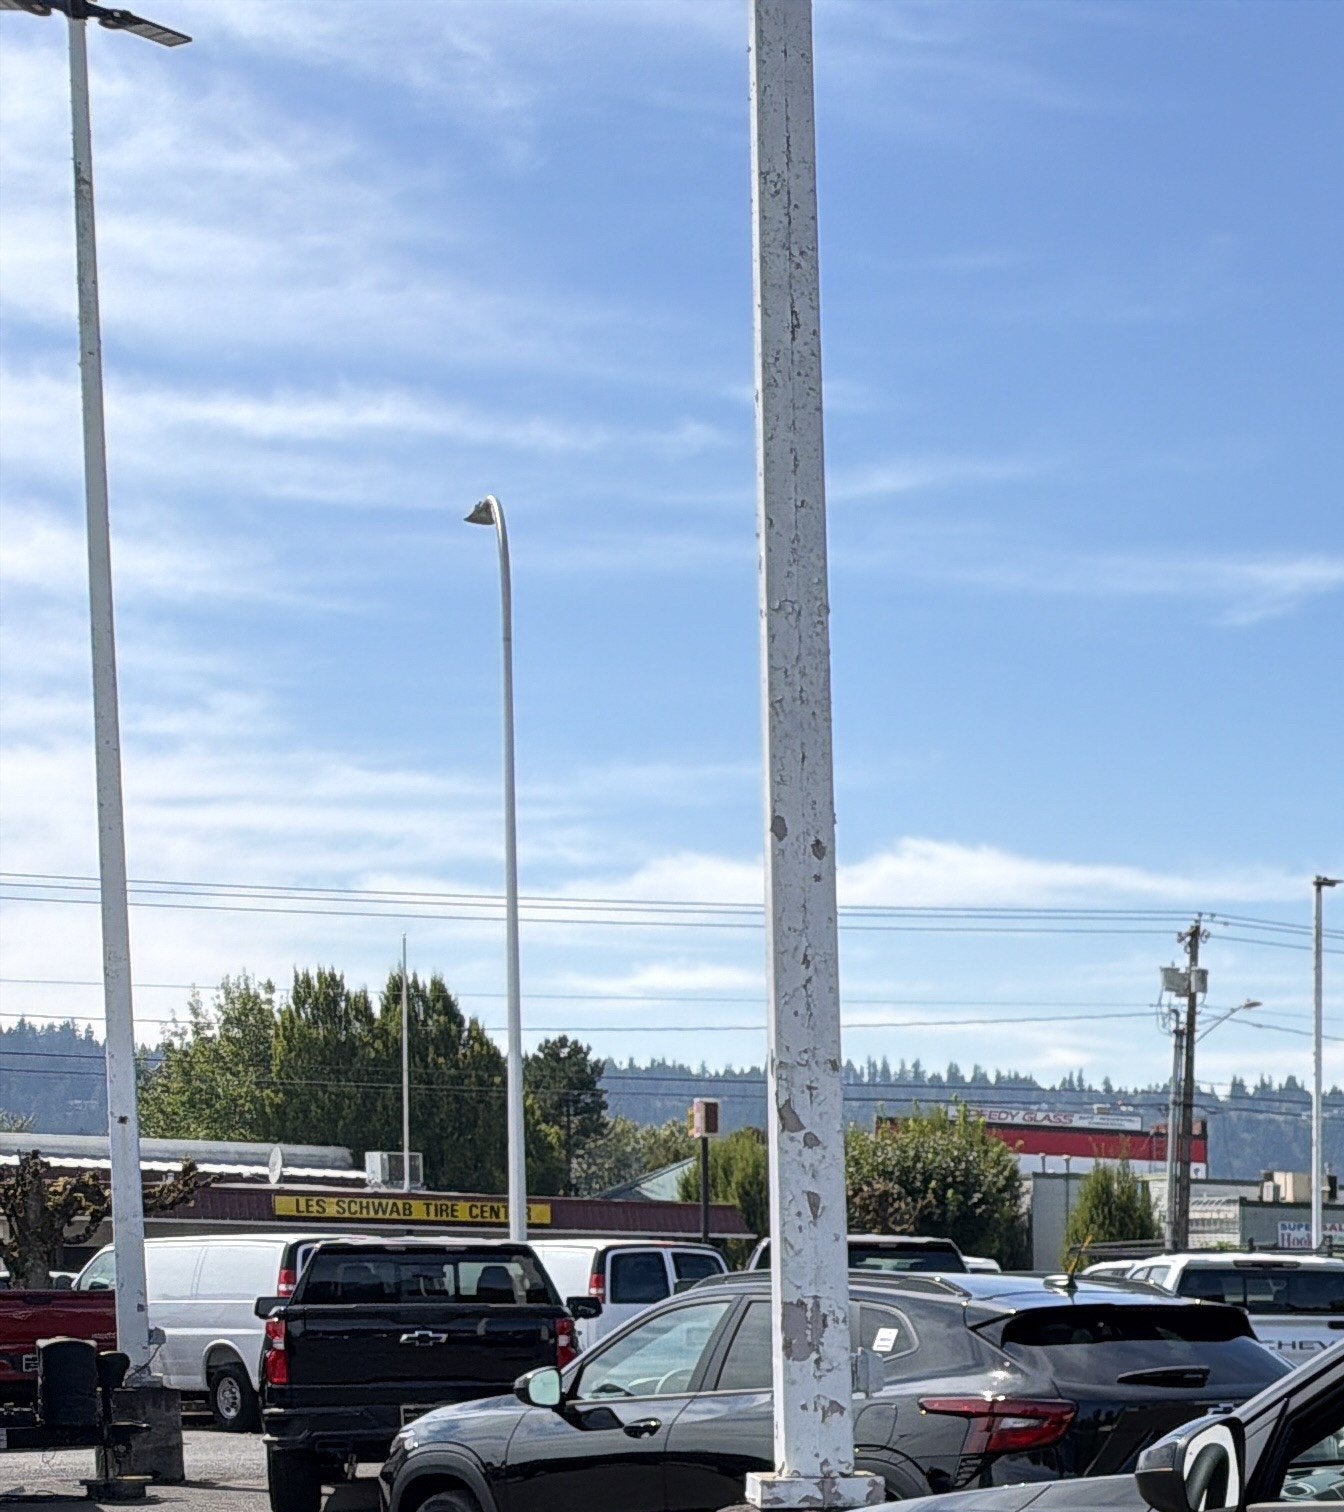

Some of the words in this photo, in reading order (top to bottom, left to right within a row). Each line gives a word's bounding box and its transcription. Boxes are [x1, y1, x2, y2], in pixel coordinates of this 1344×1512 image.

[1022, 1110, 1076, 1125] GLASS
[295, 1198, 327, 1215] LES
[335, 1199, 413, 1217] SCHWAB
[422, 1201, 460, 1218] TIRE
[468, 1202, 532, 1221] CENTR
